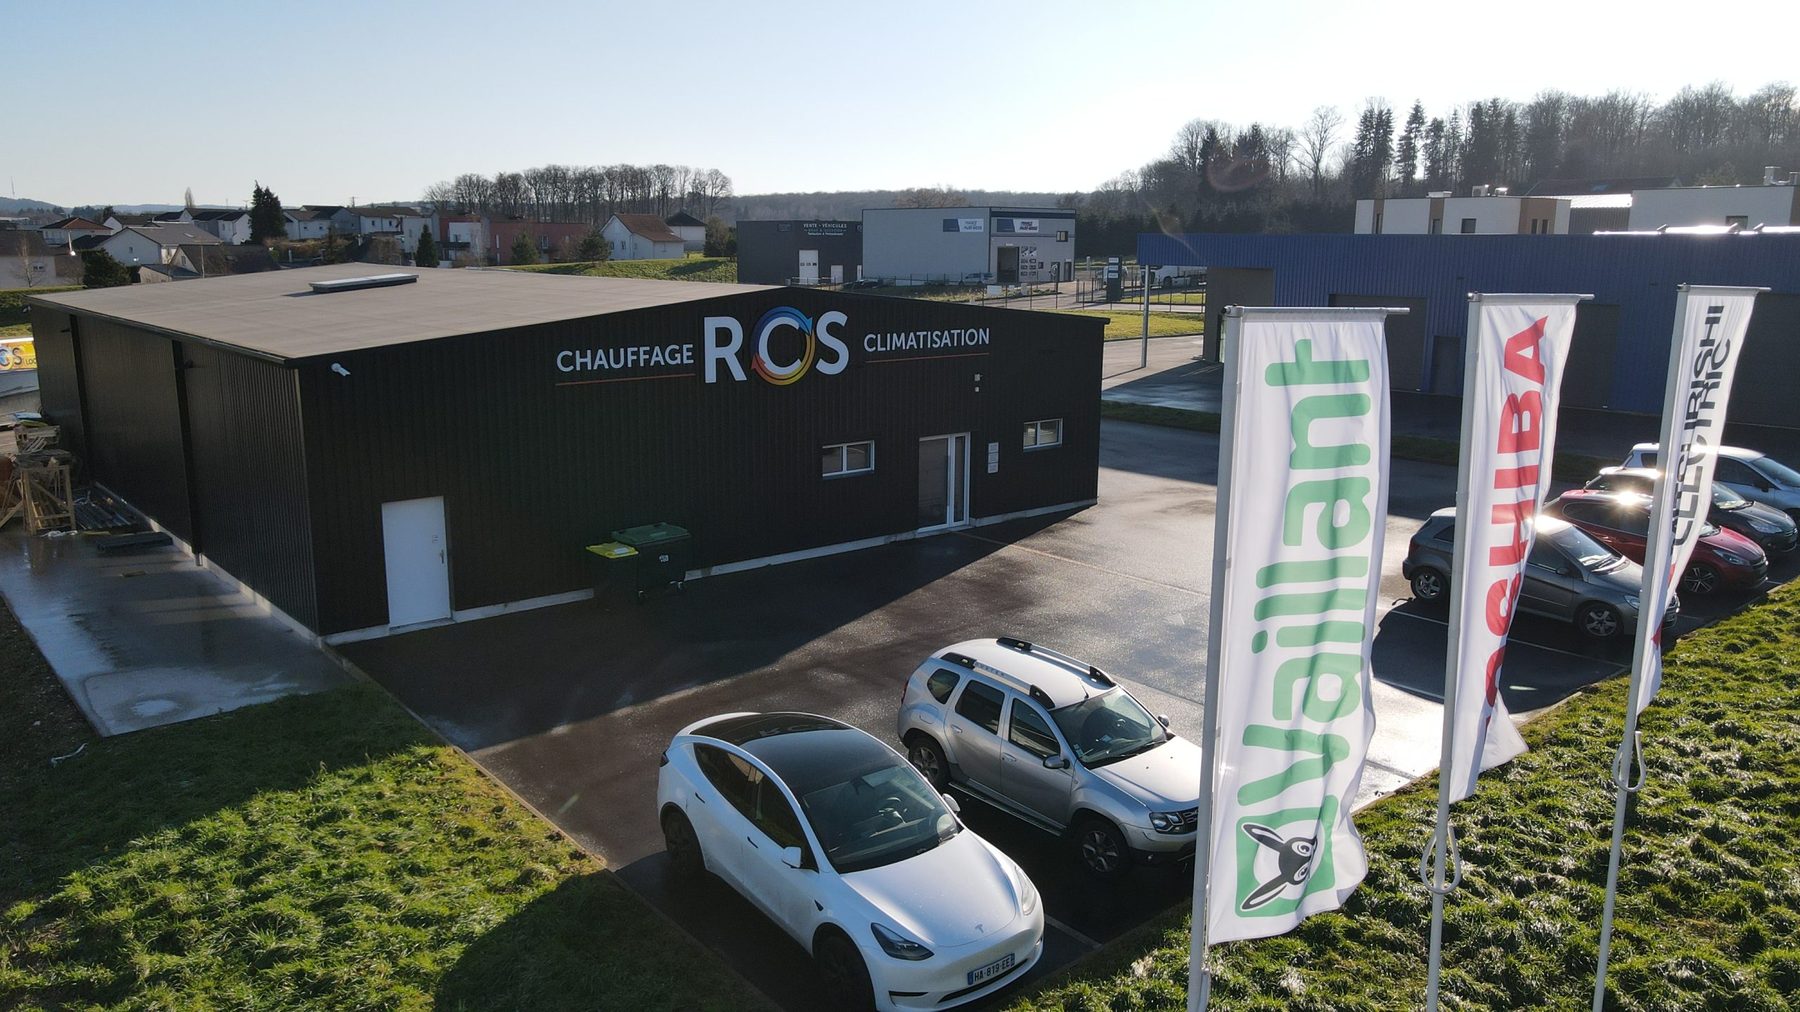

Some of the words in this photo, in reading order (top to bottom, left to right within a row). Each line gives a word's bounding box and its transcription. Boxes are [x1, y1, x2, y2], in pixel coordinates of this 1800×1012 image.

[556, 344, 694, 372] CHAUFFAGE
[704, 306, 849, 385] RCS
[863, 328, 990, 352] CLIMATISATION
[1671, 305, 1724, 555] SUBISHI
[1237, 338, 1371, 807] Vaillant
[1484, 316, 1548, 735] OSHIBA
